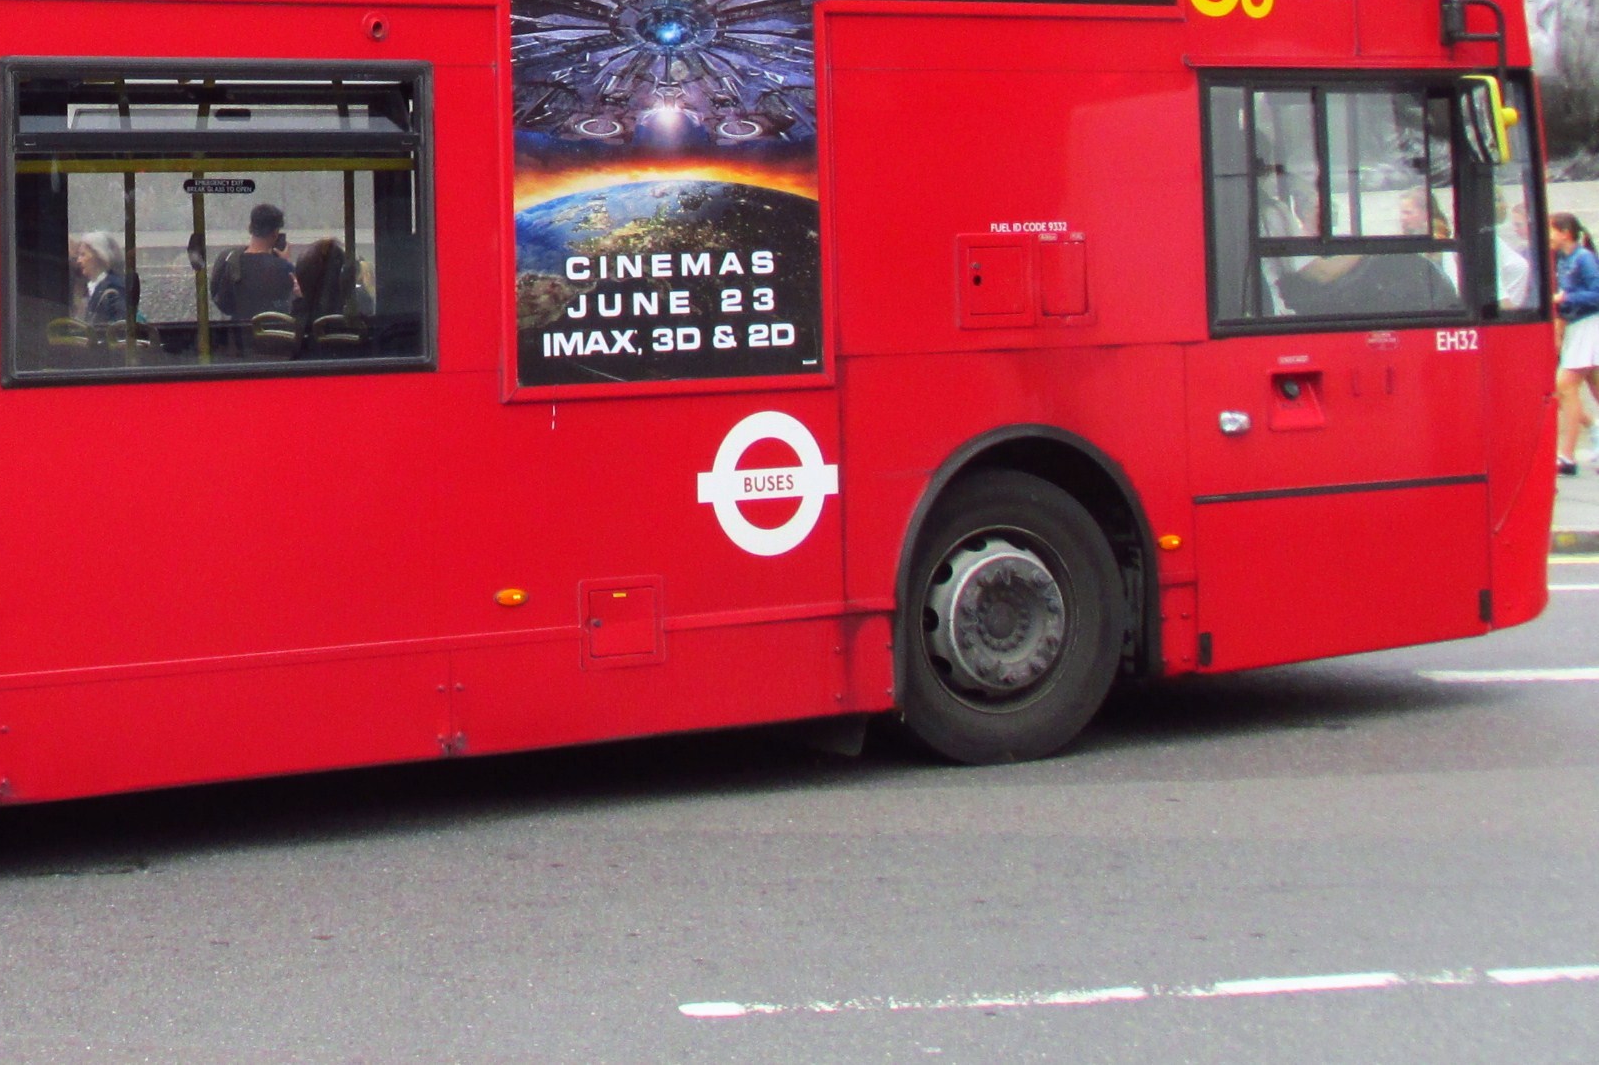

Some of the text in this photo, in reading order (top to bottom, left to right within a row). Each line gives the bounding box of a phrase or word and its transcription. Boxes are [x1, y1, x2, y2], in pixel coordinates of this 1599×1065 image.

[990, 222, 1012, 233] FUEL
[1012, 222, 1022, 232] ID
[1022, 221, 1047, 232] CODE
[565, 250, 775, 281] CINEMAS
[567, 287, 775, 319] JUNE 23
[652, 327, 701, 352] 3D
[712, 325, 738, 349] &
[747, 322, 796, 348] 2D
[1435, 329, 1479, 352] EH32
[743, 473, 795, 494] BUSES
